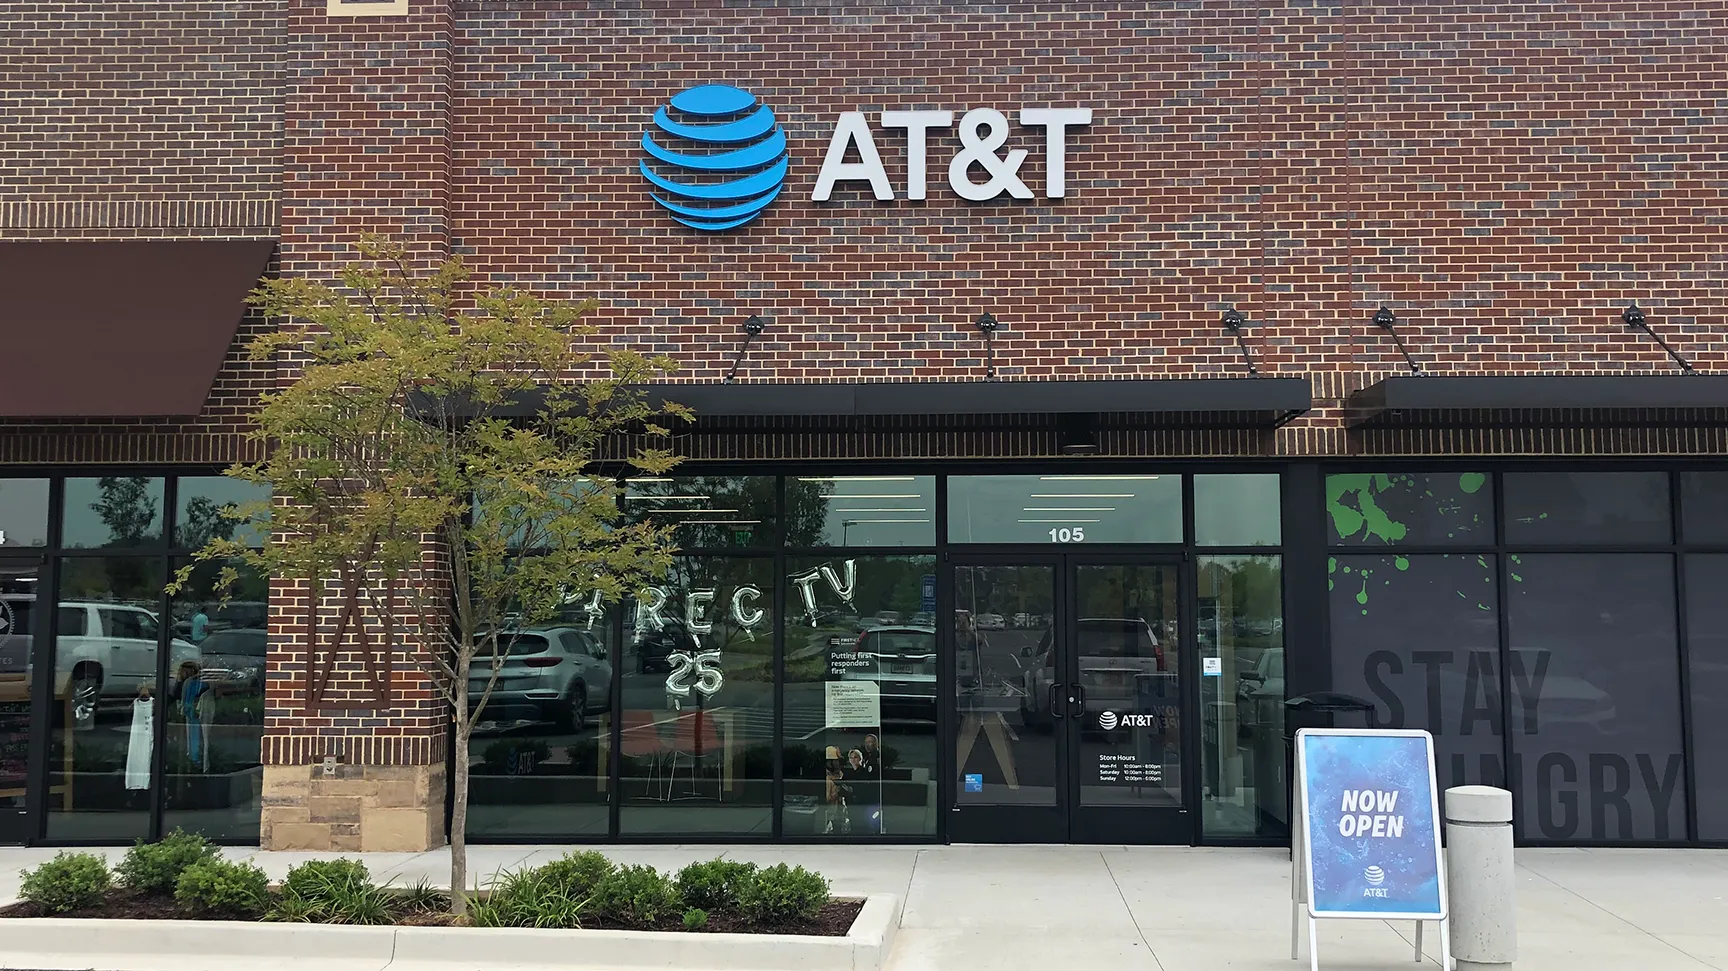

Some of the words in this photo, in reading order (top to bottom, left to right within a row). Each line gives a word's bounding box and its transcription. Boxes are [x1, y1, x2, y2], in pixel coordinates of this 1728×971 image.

[811, 107, 1092, 200] AT&T
[1049, 527, 1085, 543] 105
[831, 652, 857, 660] Putting
[857, 652, 872, 660] first
[664, 647, 726, 699] 25
[1363, 650, 1552, 736] STAY
[1121, 714, 1153, 727] AT&T
[1341, 790, 1399, 813] NOW
[1436, 752, 1684, 839] NGRY
[1339, 814, 1404, 838] OPEN
[1363, 888, 1389, 898] AT&T
